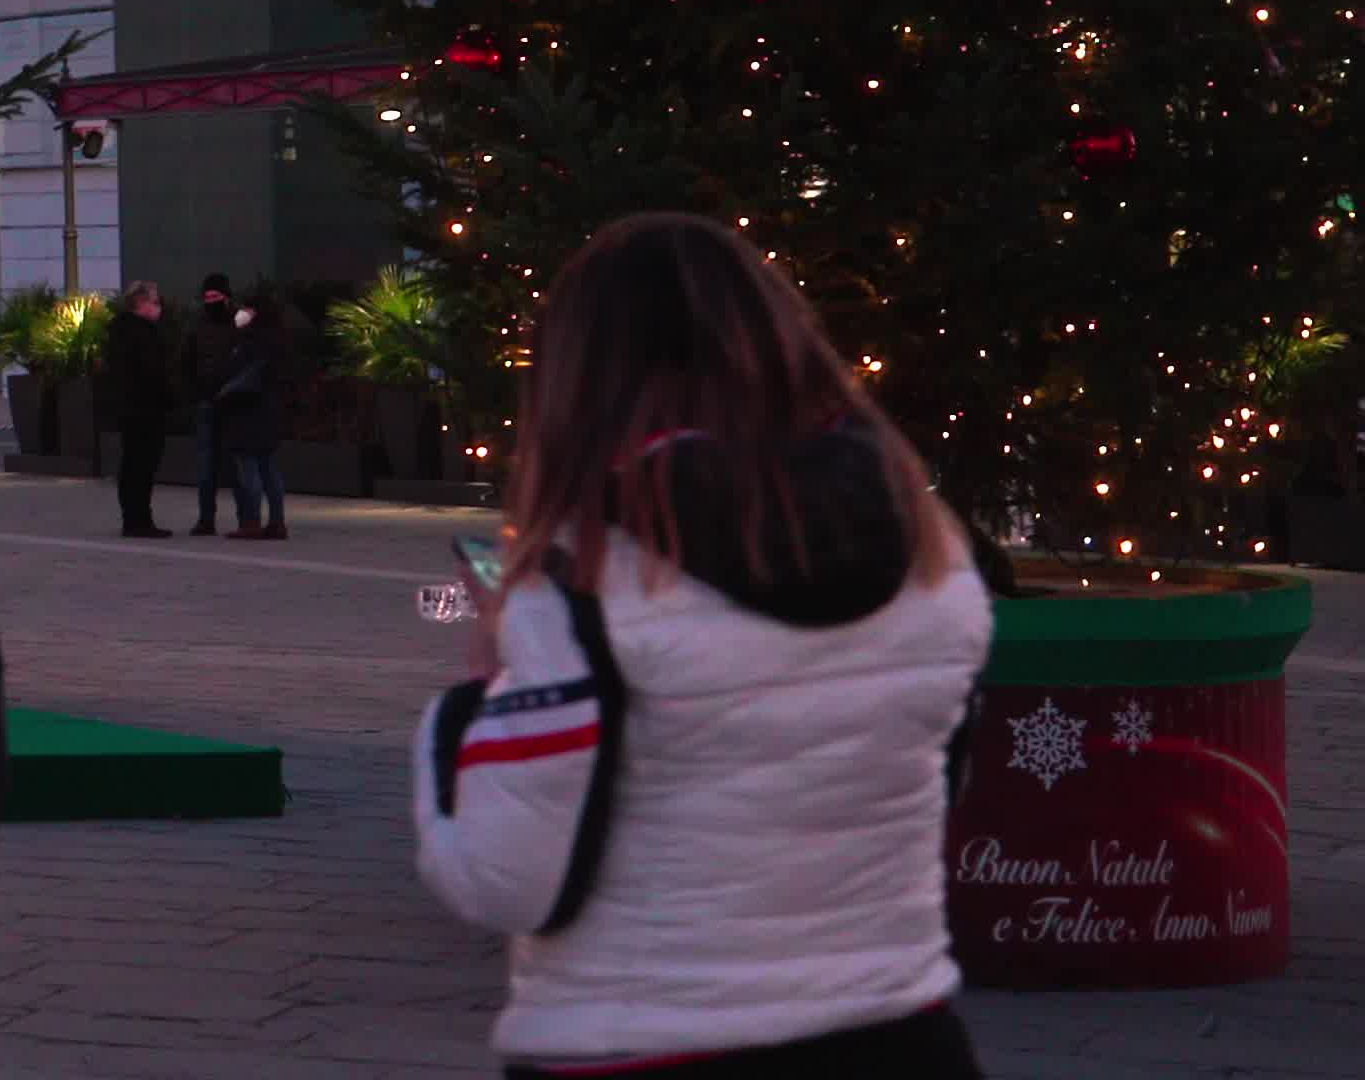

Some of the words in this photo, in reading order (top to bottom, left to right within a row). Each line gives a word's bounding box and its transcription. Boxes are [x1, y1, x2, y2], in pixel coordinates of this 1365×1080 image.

[956, 834, 1062, 886] Buon
[1063, 838, 1175, 886] Natale
[991, 914, 1014, 944] e
[1020, 896, 1129, 944] Felice
[1132, 894, 1212, 943] Anno
